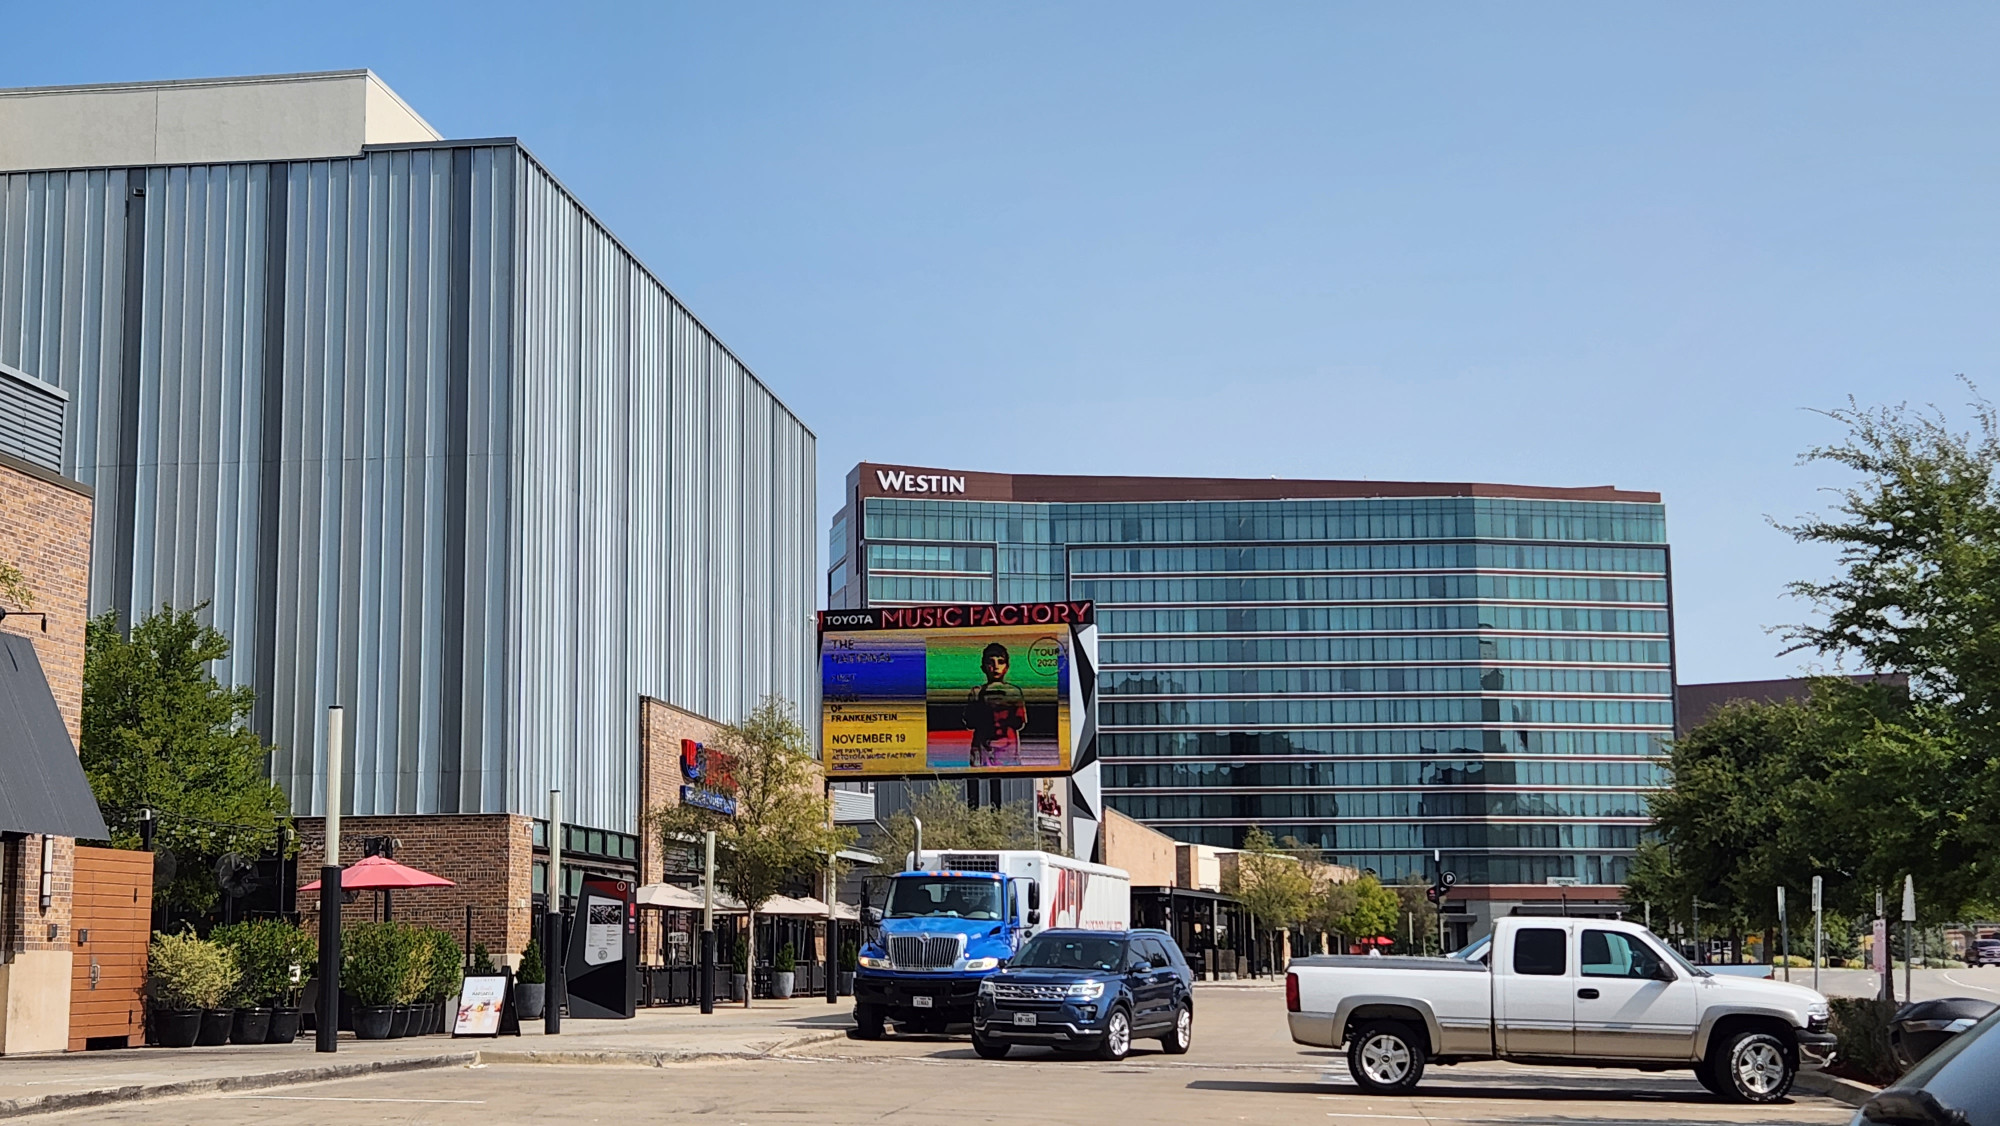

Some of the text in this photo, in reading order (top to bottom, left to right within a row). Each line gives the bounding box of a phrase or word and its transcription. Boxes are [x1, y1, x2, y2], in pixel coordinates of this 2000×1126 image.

[825, 602, 1091, 628] TOYOTA MUSIC FACTORY
[831, 639, 854, 650] THE
[1033, 648, 1060, 657] TOUR
[1037, 658, 1058, 668] 2023
[831, 704, 842, 713] OF
[831, 713, 897, 722] FRANKENSTEIN
[832, 733, 906, 744] NOVEMBER 19
[887, 752, 917, 760] FACTORY
[1446, 874, 1453, 883] P
